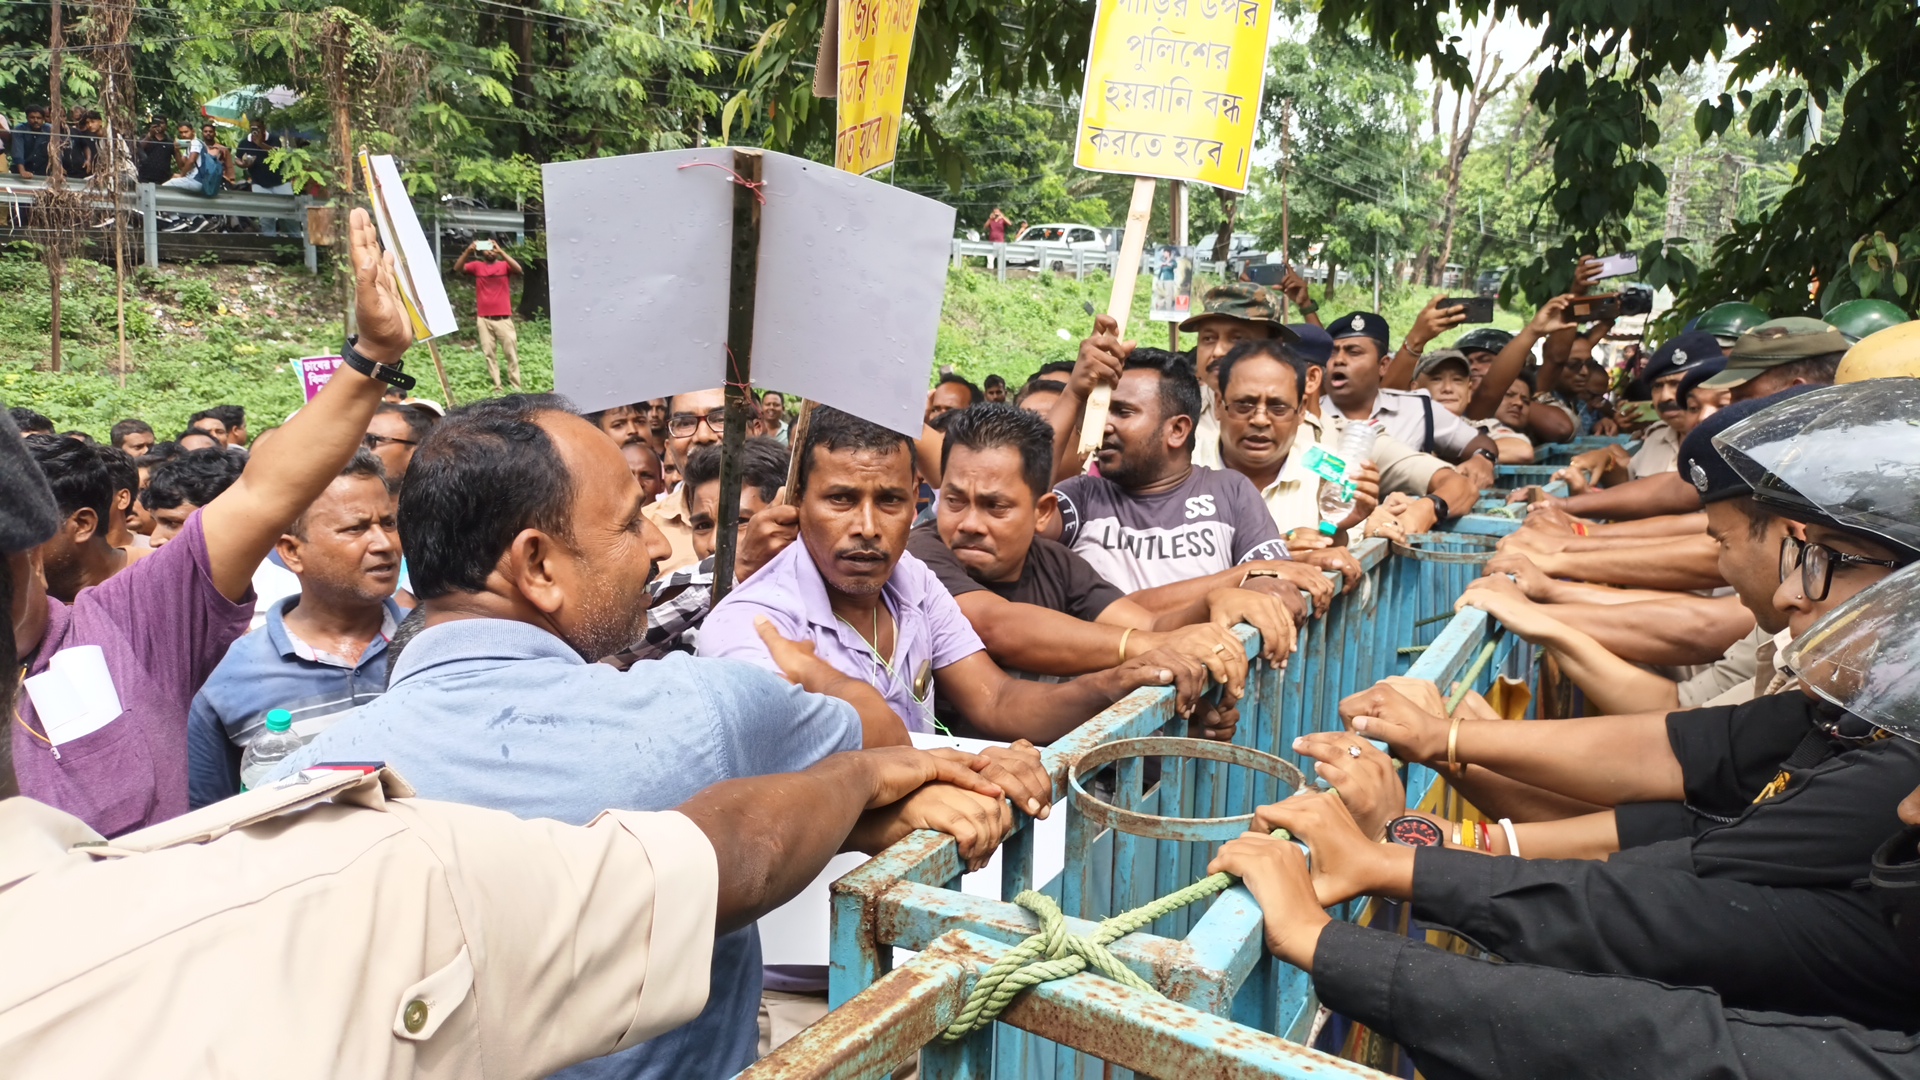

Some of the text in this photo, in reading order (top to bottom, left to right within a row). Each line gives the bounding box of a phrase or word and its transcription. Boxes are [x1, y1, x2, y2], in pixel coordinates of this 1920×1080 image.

[1126, 26, 1231, 72] পুলিশের
[1104, 76, 1243, 124] হয়রানি বন্ধ
[859, 116, 882, 165] হবে
[1088, 126, 1166, 158] করতে
[1173, 136, 1224, 167] হবে
[1185, 494, 1216, 519] SS
